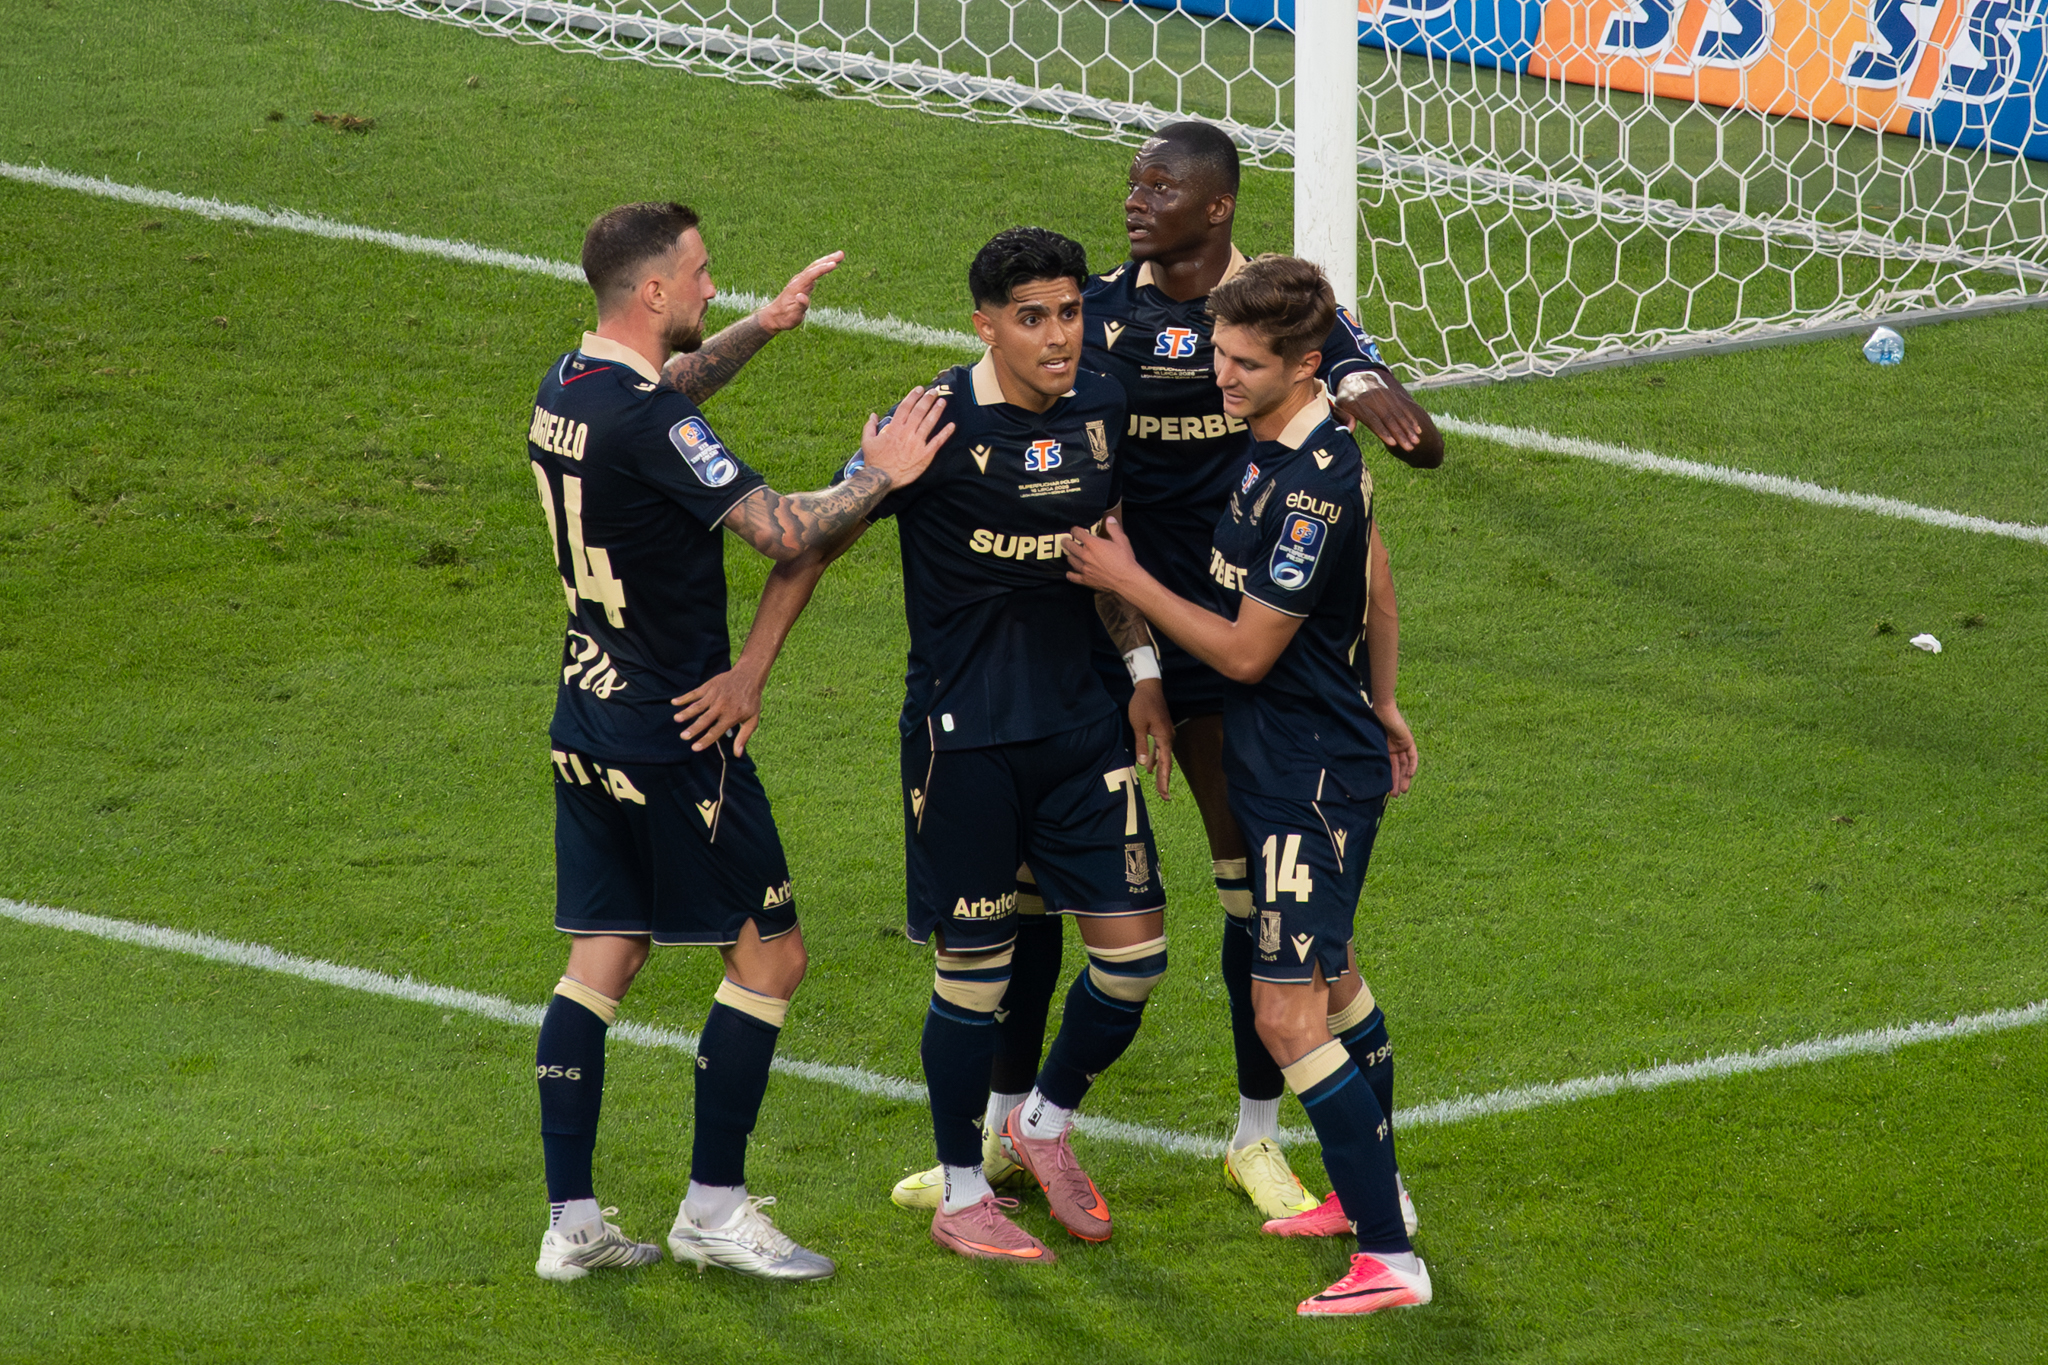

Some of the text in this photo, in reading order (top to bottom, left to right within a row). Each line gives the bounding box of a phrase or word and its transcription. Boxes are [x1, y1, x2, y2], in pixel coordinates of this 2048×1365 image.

[1154, 327, 1198, 358] STS
[1024, 439, 1062, 472] STS
[1286, 490, 1341, 524] ebury
[1296, 526, 1313, 540] STS
[1262, 834, 1313, 903] 14
[535, 1065, 581, 1080] 956
